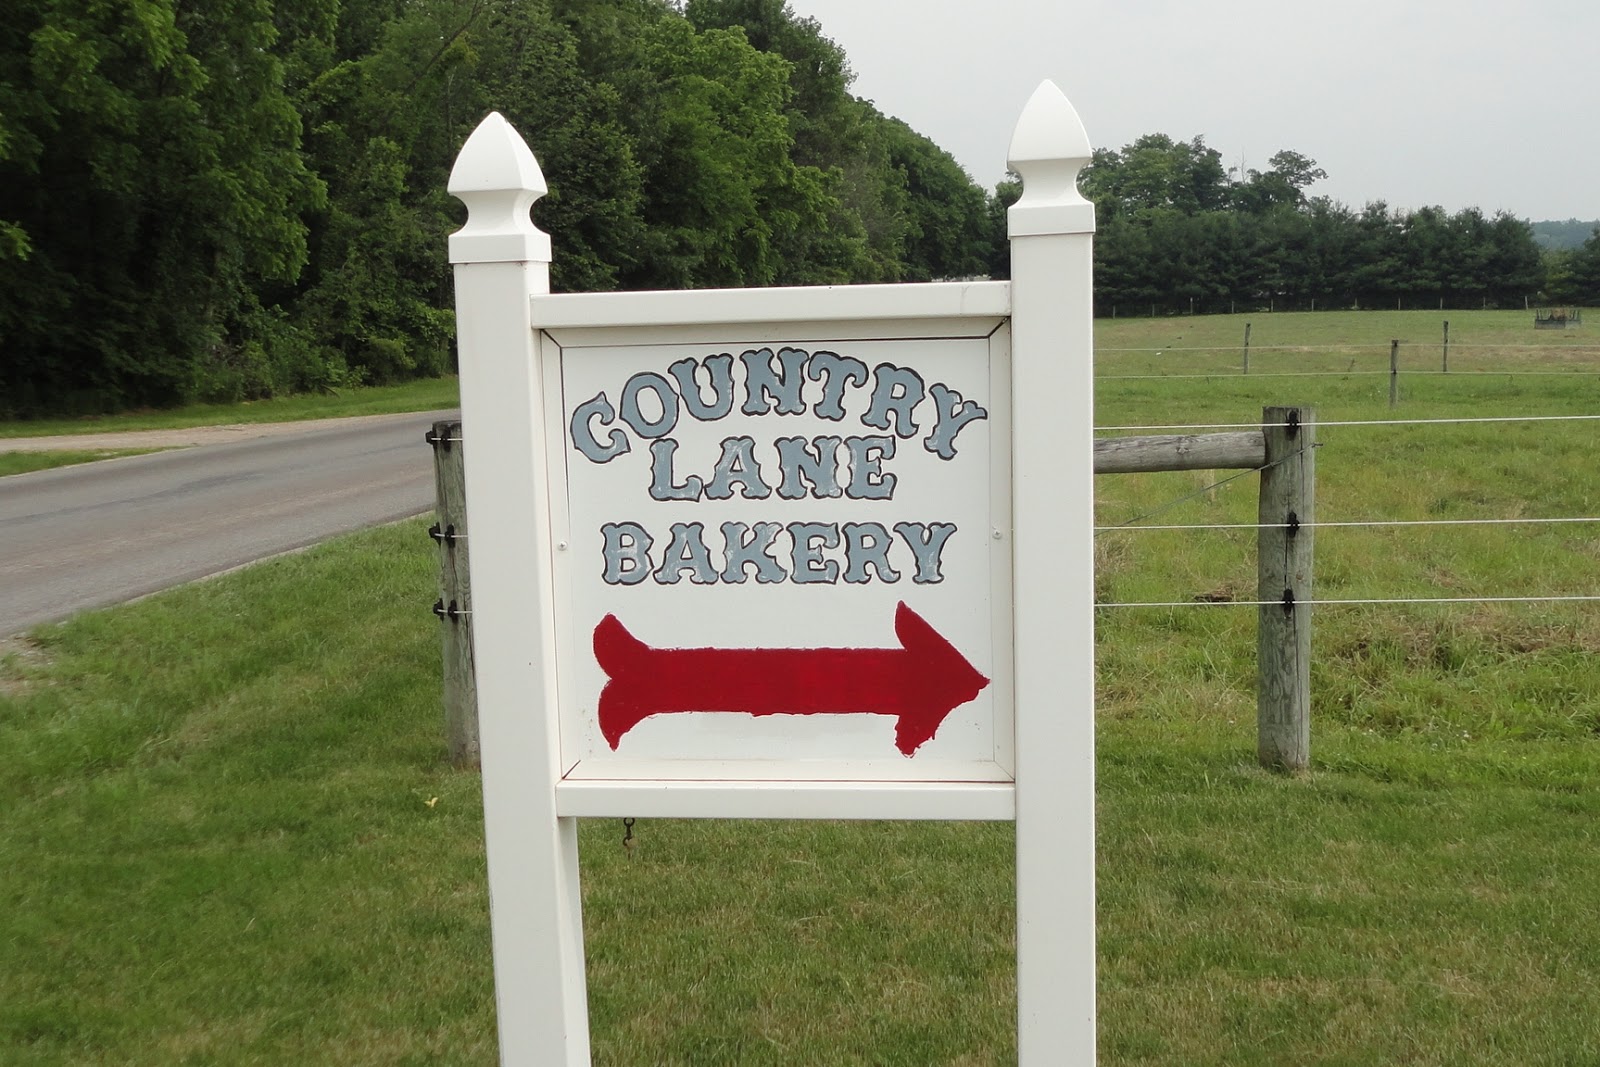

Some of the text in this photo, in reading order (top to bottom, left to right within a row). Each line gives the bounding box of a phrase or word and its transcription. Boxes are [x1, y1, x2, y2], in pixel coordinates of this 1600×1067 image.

[570, 347, 988, 463] COUNTRY
[648, 435, 897, 502] LANE
[600, 522, 957, 585] BAKERY
